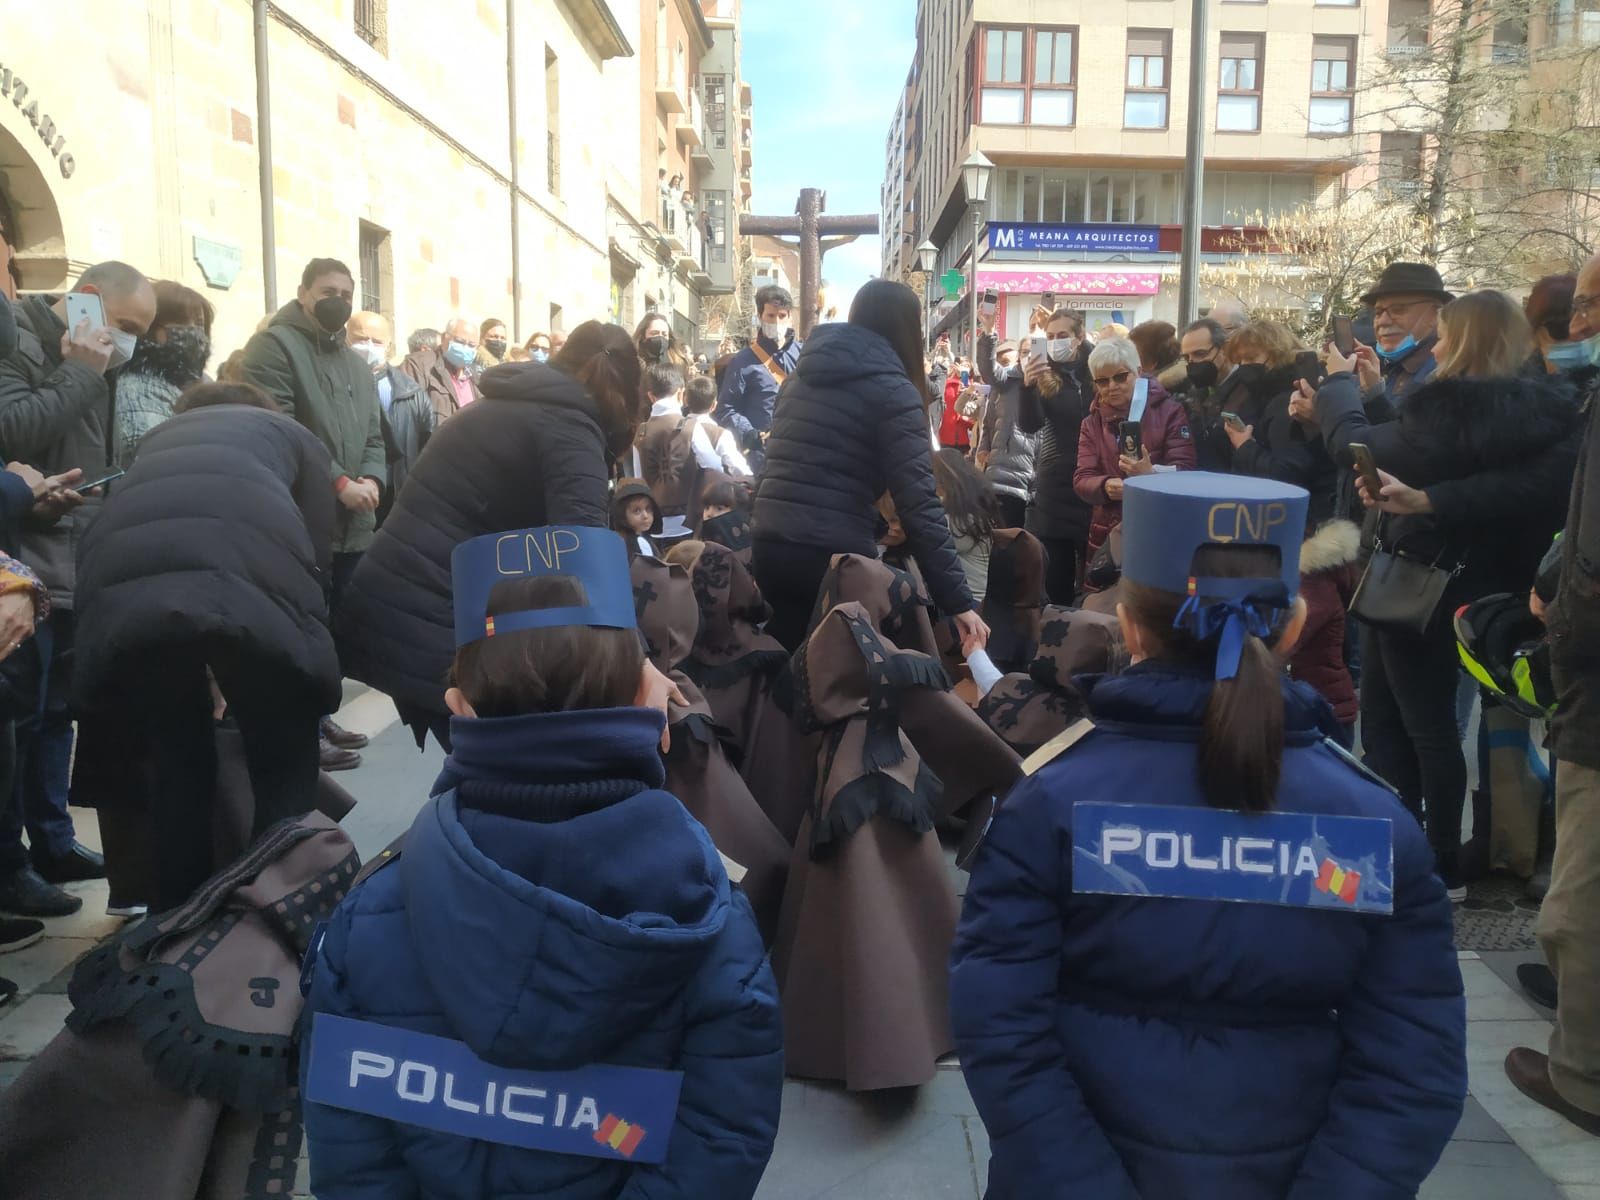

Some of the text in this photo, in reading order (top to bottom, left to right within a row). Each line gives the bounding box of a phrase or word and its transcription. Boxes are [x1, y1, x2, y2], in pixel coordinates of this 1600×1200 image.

[0, 63, 76, 180] ITARIO
[1029, 231, 1154, 243] MEANA ARQUITECTOS
[1208, 502, 1287, 543] CNP
[496, 530, 580, 574] CNP
[1103, 828, 1319, 878] POLICIA
[350, 1050, 599, 1130] POLICIA
